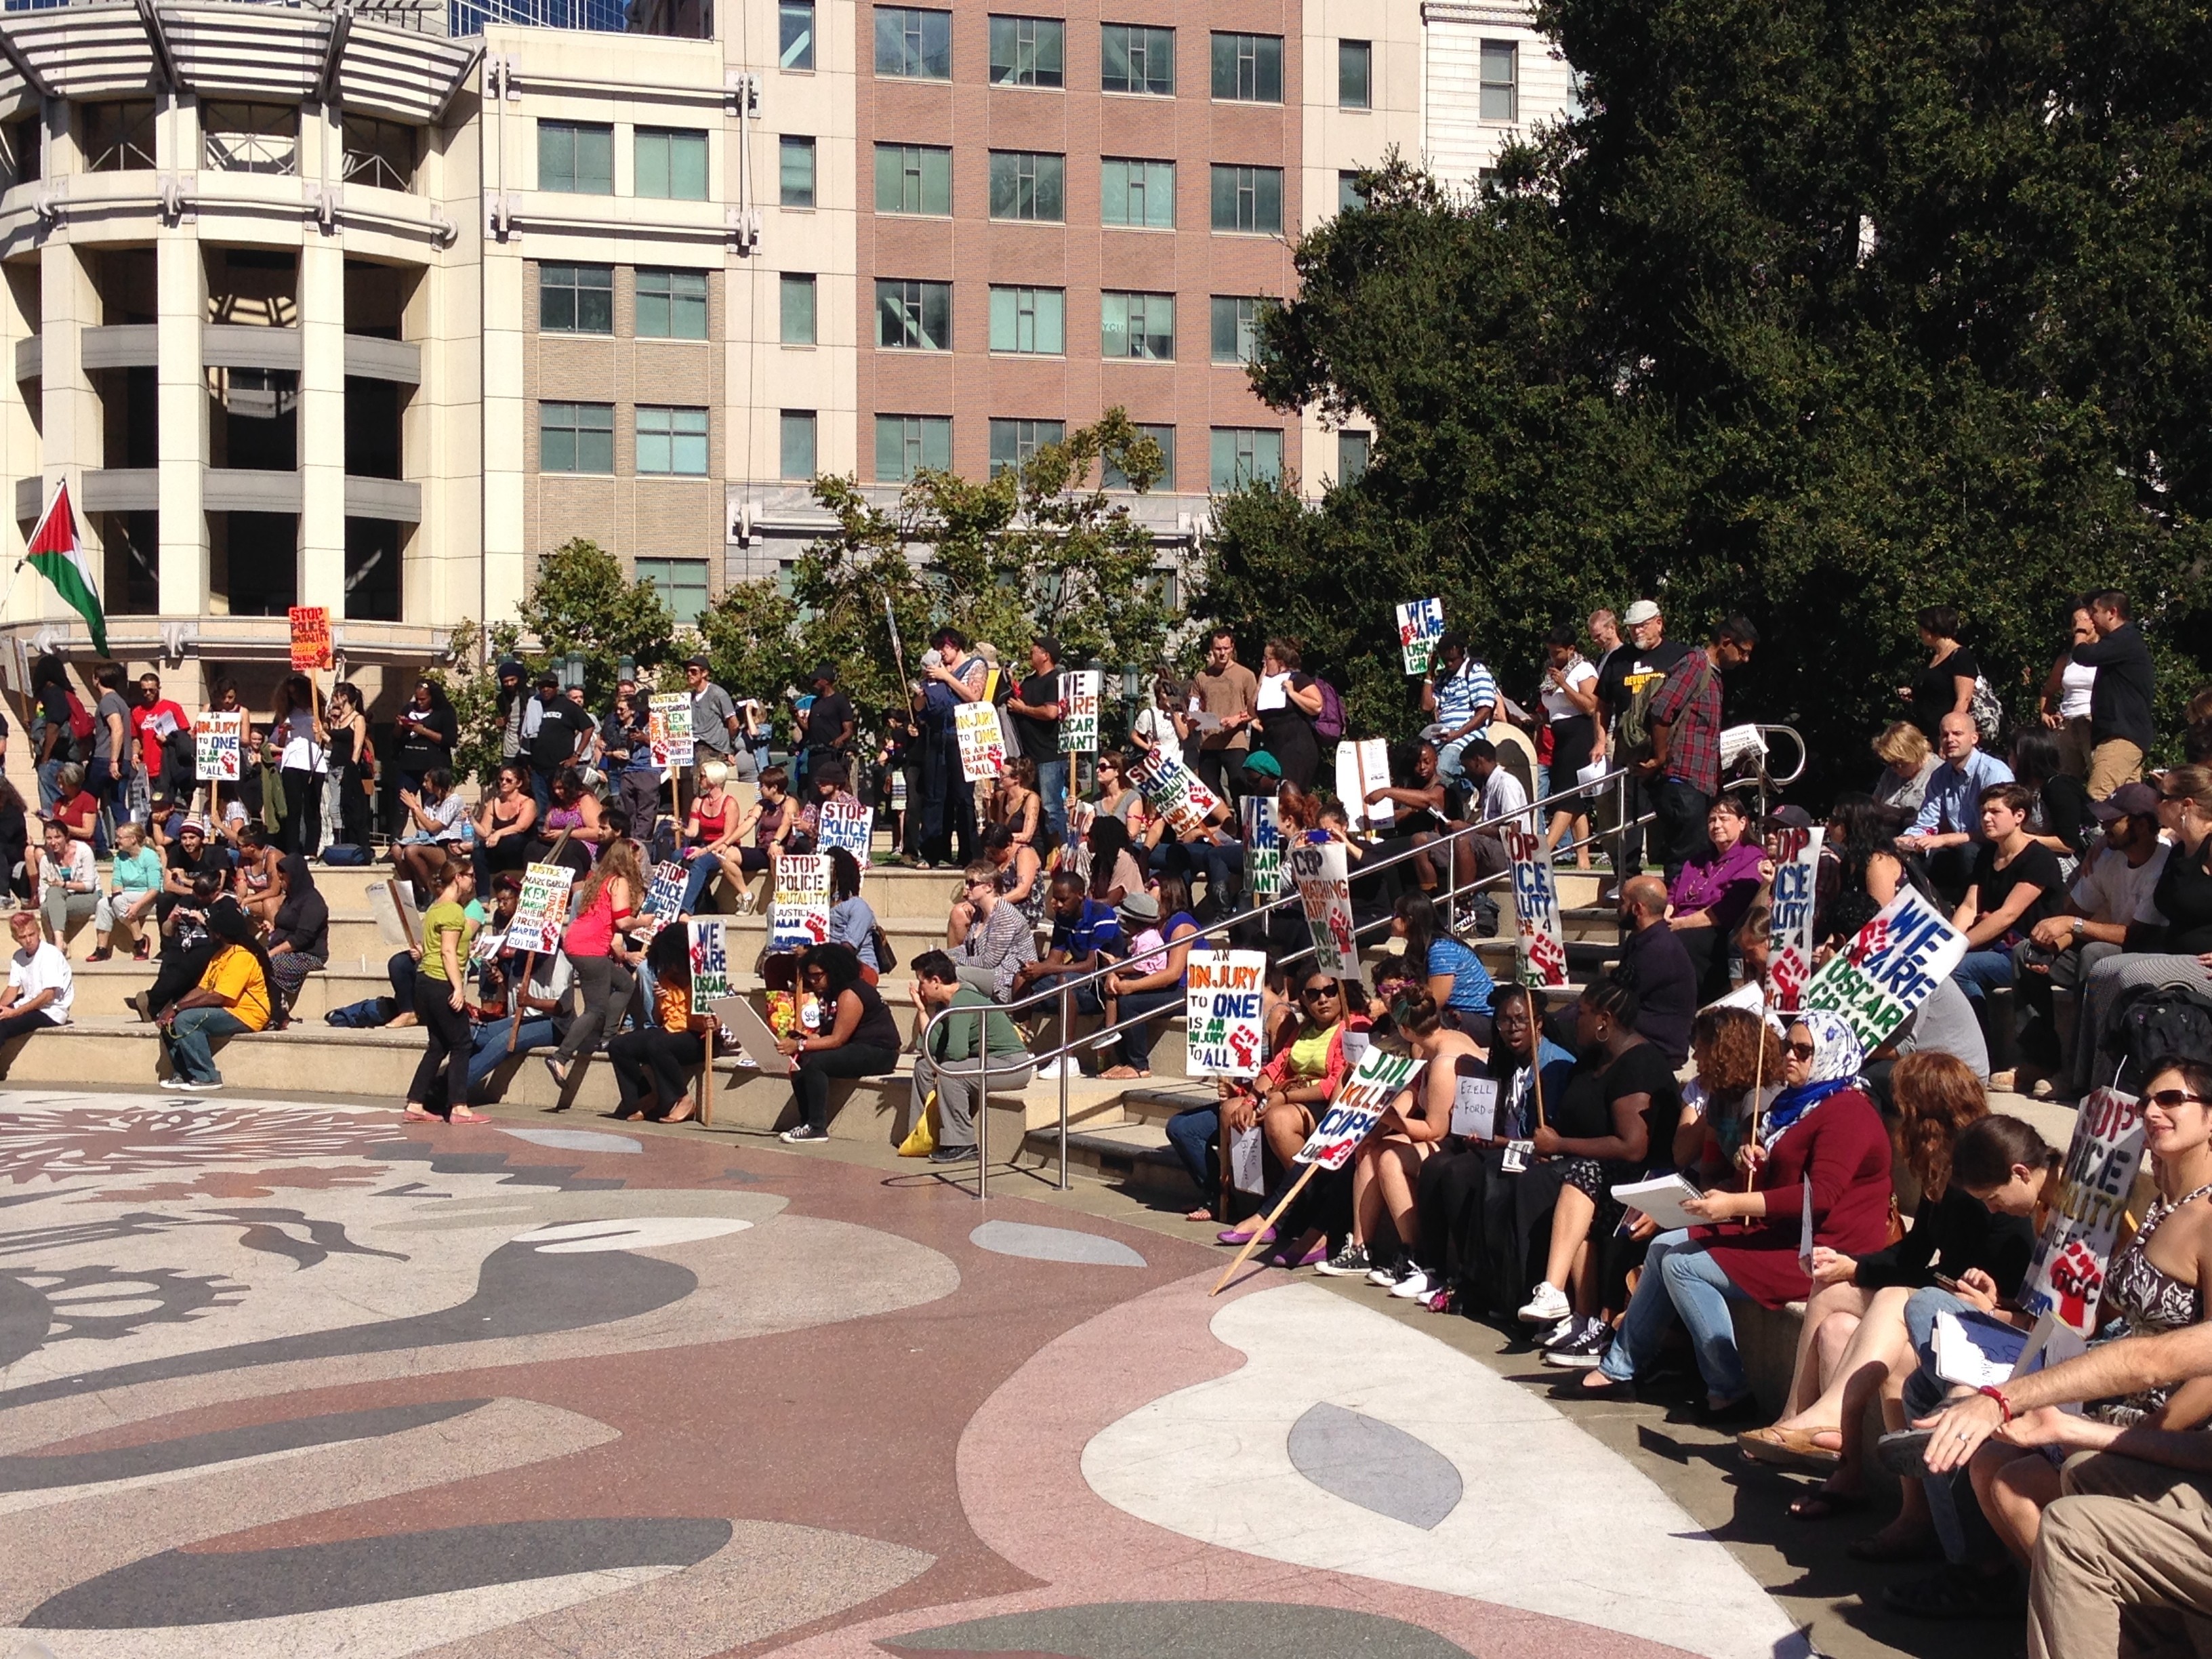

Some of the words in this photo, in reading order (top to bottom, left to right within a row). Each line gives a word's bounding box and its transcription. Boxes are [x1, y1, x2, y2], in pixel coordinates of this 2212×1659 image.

[291, 608, 323, 621] STOP
[956, 711, 994, 730] INJURY
[211, 736, 238, 750] ONE
[974, 728, 999, 744] ONE
[206, 765, 222, 776] ALL
[975, 764, 992, 775] ALL
[825, 804, 867, 820] STOP
[821, 818, 868, 838] POLICE
[529, 864, 561, 878] JUSTICE
[780, 857, 820, 874] STOP
[1292, 850, 1323, 876] COP
[657, 862, 687, 883] STOP
[777, 874, 824, 891] POLICE
[523, 886, 549, 900] KEN
[775, 892, 827, 905] BRUTALITY
[1887, 897, 1954, 956] WE
[697, 923, 720, 949] WE
[1213, 949, 1230, 961] AN
[694, 975, 726, 993] OSCAR
[1189, 964, 1261, 991] INJURY
[1862, 945, 1938, 1010] ARE
[1826, 958, 1904, 1035] OSCAR
[1189, 995, 1208, 1008] TO
[1213, 993, 1259, 1019] ONE
[1189, 1017, 1203, 1030] IS
[1206, 1017, 1225, 1031] AN
[1189, 1030, 1227, 1046] INJURY
[1189, 1044, 1202, 1061] TO
[1202, 1048, 1230, 1068] ALL
[1358, 1052, 1415, 1087] JAIL
[1460, 1080, 1493, 1095] EZELL
[1464, 1101, 1486, 1115] FORD
